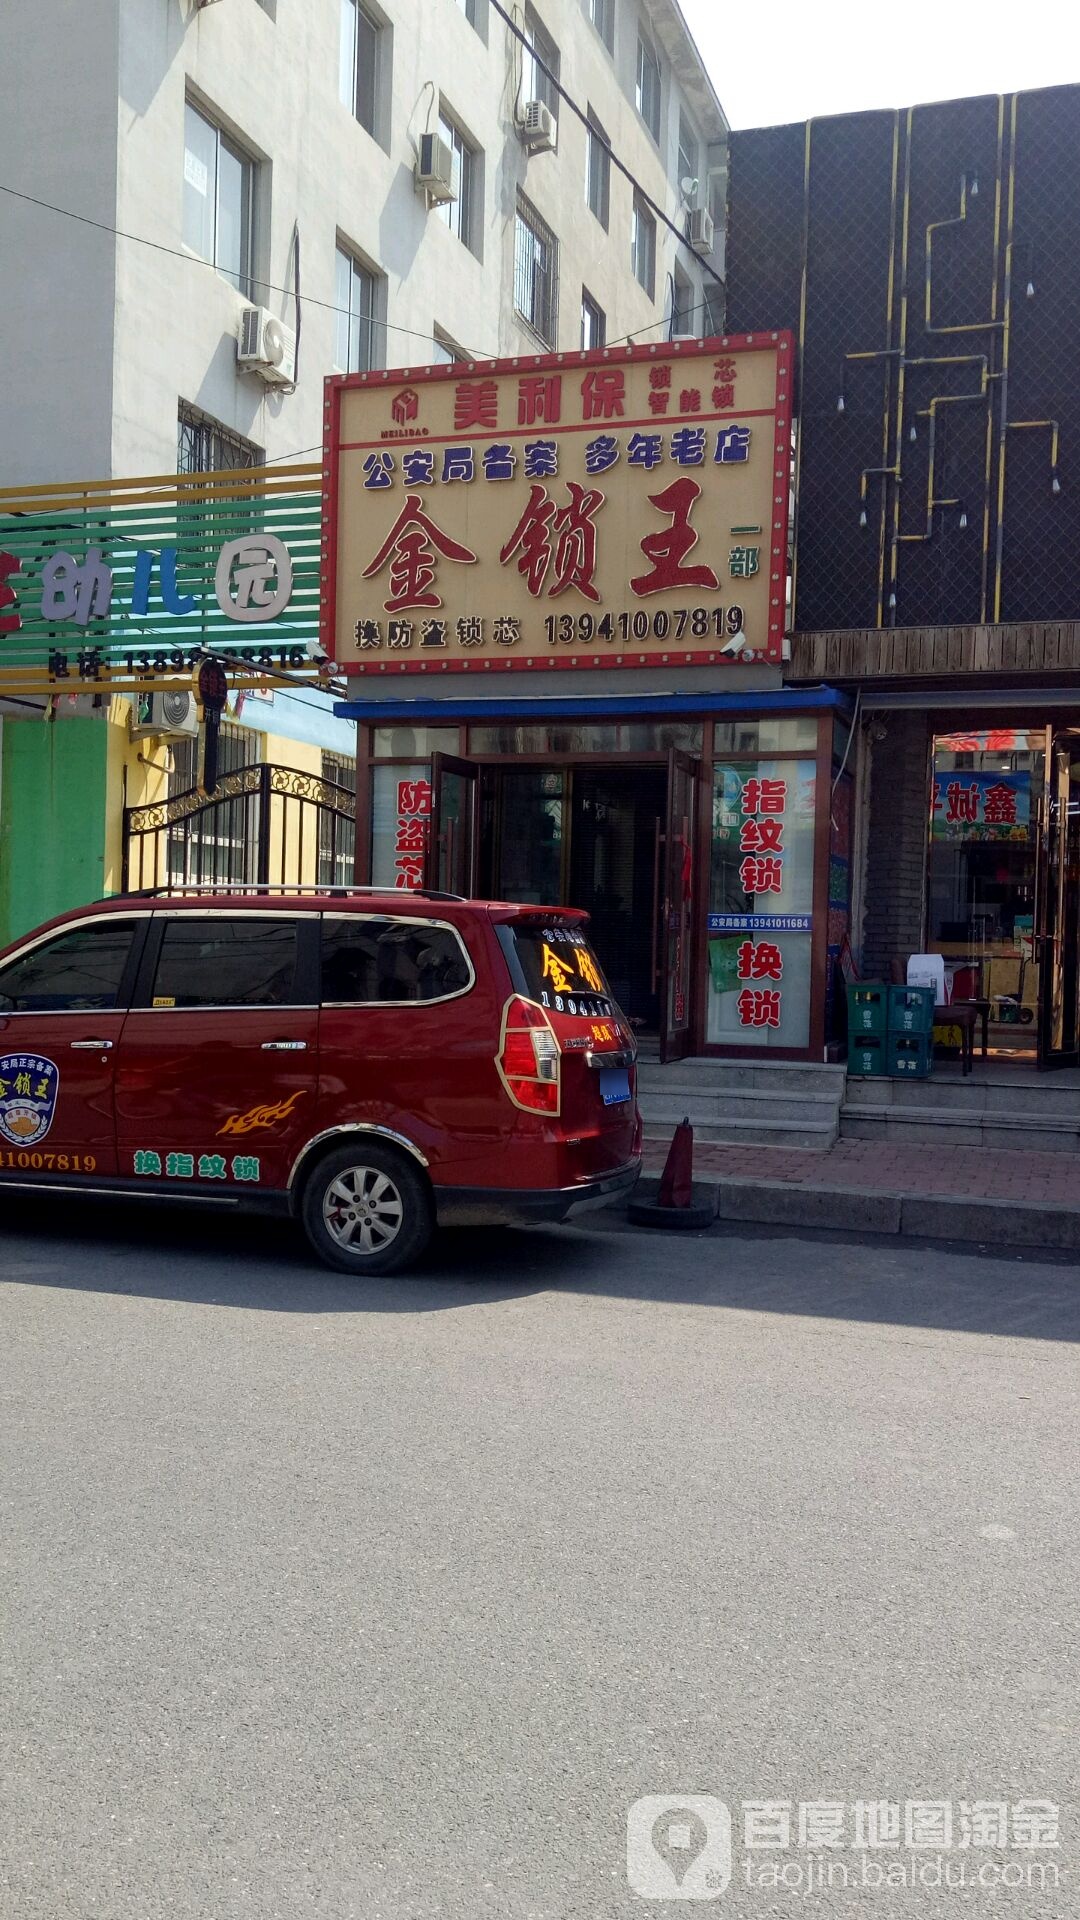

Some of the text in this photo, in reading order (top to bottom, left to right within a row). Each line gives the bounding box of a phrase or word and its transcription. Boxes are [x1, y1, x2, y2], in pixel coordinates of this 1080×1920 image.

[453, 369, 626, 430] 美利保
[648, 384, 735, 415] 智能锁
[362, 424, 752, 490] 公安局备案 多年老店
[380, 427, 430, 439] MEILIBAO
[361, 476, 721, 615] 金锁王
[728, 524, 762, 579] 一部
[0, 533, 293, 632] 幼儿园
[353, 605, 745, 649] 换防盗锁芯 13941007819
[740, 778, 787, 894] 指纹锁
[711, 917, 809, 929] 公安局备案 13941011684
[737, 941, 783, 1028] 换锁
[134, 1150, 260, 1182] 换指纹锁
